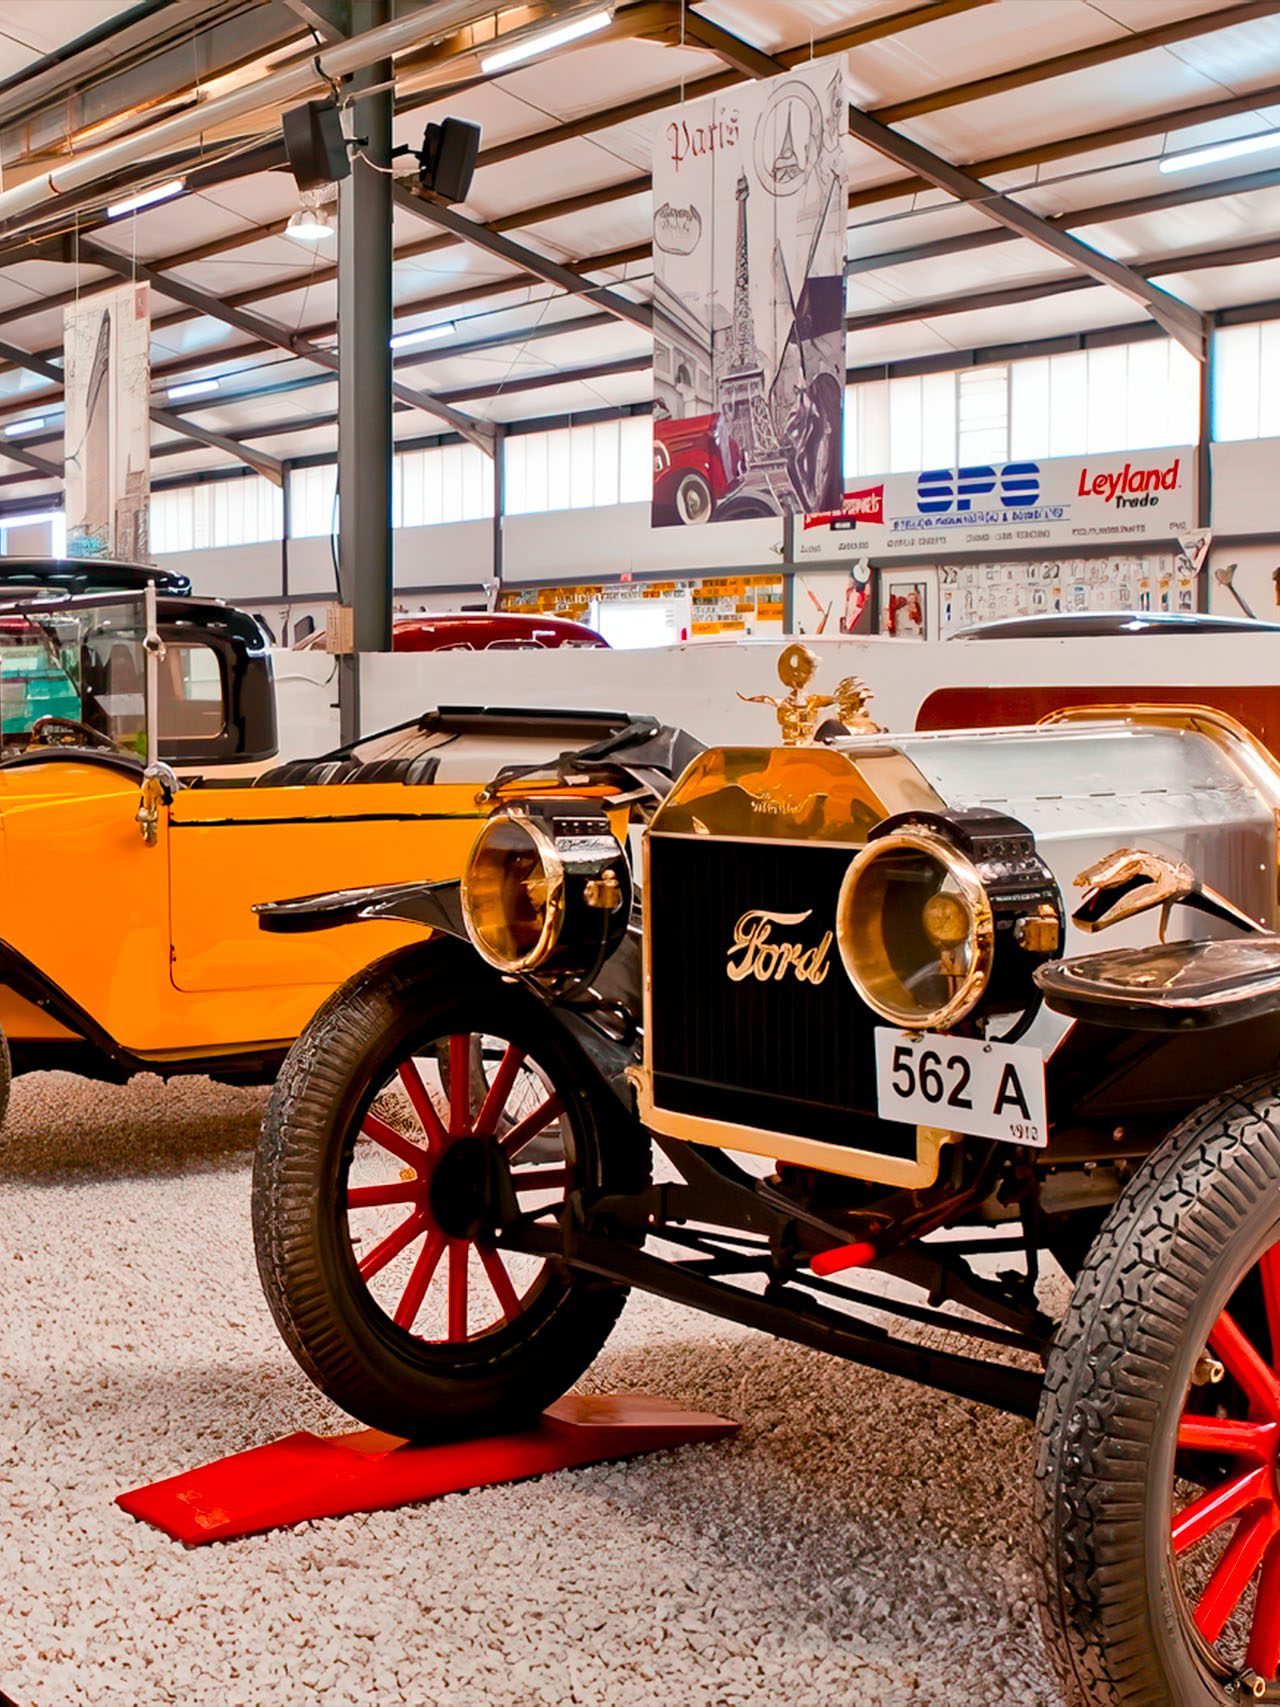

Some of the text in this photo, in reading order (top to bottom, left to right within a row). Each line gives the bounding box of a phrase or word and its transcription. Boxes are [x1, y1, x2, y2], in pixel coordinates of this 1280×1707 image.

[667, 114, 740, 172] Paris
[917, 462, 1040, 513] SPS
[1078, 459, 1180, 502] Leyland
[727, 909, 833, 984] Ford
[892, 1045, 1032, 1120] 562 A
